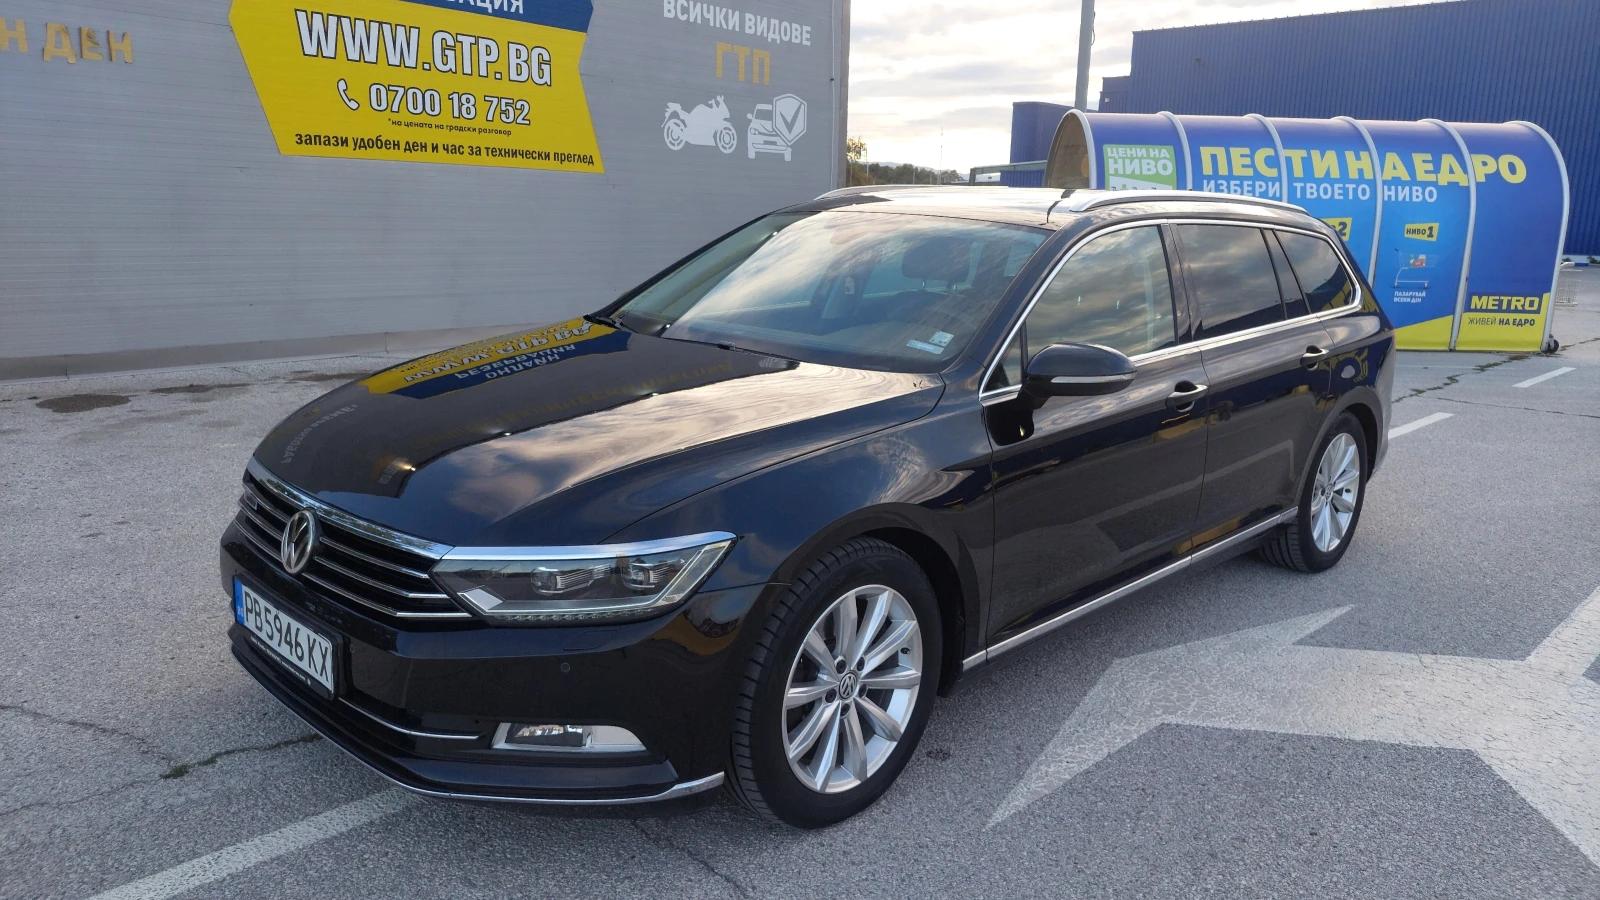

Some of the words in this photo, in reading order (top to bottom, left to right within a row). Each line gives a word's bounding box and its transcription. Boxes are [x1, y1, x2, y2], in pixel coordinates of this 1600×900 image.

[663, 0, 740, 32] ВСИЧКИ
[744, 12, 812, 46] ВИДОВЕ
[43, 22, 133, 64] ДЕН
[294, 8, 552, 87] WWW.GTP.BG
[716, 41, 771, 86] ГТП
[369, 82, 442, 117] 0700
[448, 91, 477, 120] 18
[483, 95, 531, 126] 752
[403, 121, 433, 129] цената
[445, 124, 477, 133] градски
[478, 127, 512, 137] разговор
[295, 133, 349, 148] запази
[352, 135, 401, 151] удобен
[403, 140, 428, 154] ден
[431, 142, 439, 153] и
[442, 143, 465, 155] час
[467, 145, 482, 157] за
[484, 146, 551, 161] технически
[553, 151, 595, 166] преглед
[1107, 147, 1147, 158] ЦЕНИ
[1149, 148, 1170, 158] НА
[1108, 158, 1173, 176] НИВО
[1203, 179, 1280, 198] ИЗБЕРИ
[1293, 182, 1371, 201] ТВОЕТО
[1383, 185, 1438, 203] НИВО
[1470, 295, 1539, 311] METRO
[1468, 317, 1496, 326] ЖИВЕЙ
[1498, 318, 1510, 326] НА
[1512, 318, 1535, 327] ЕДРО
